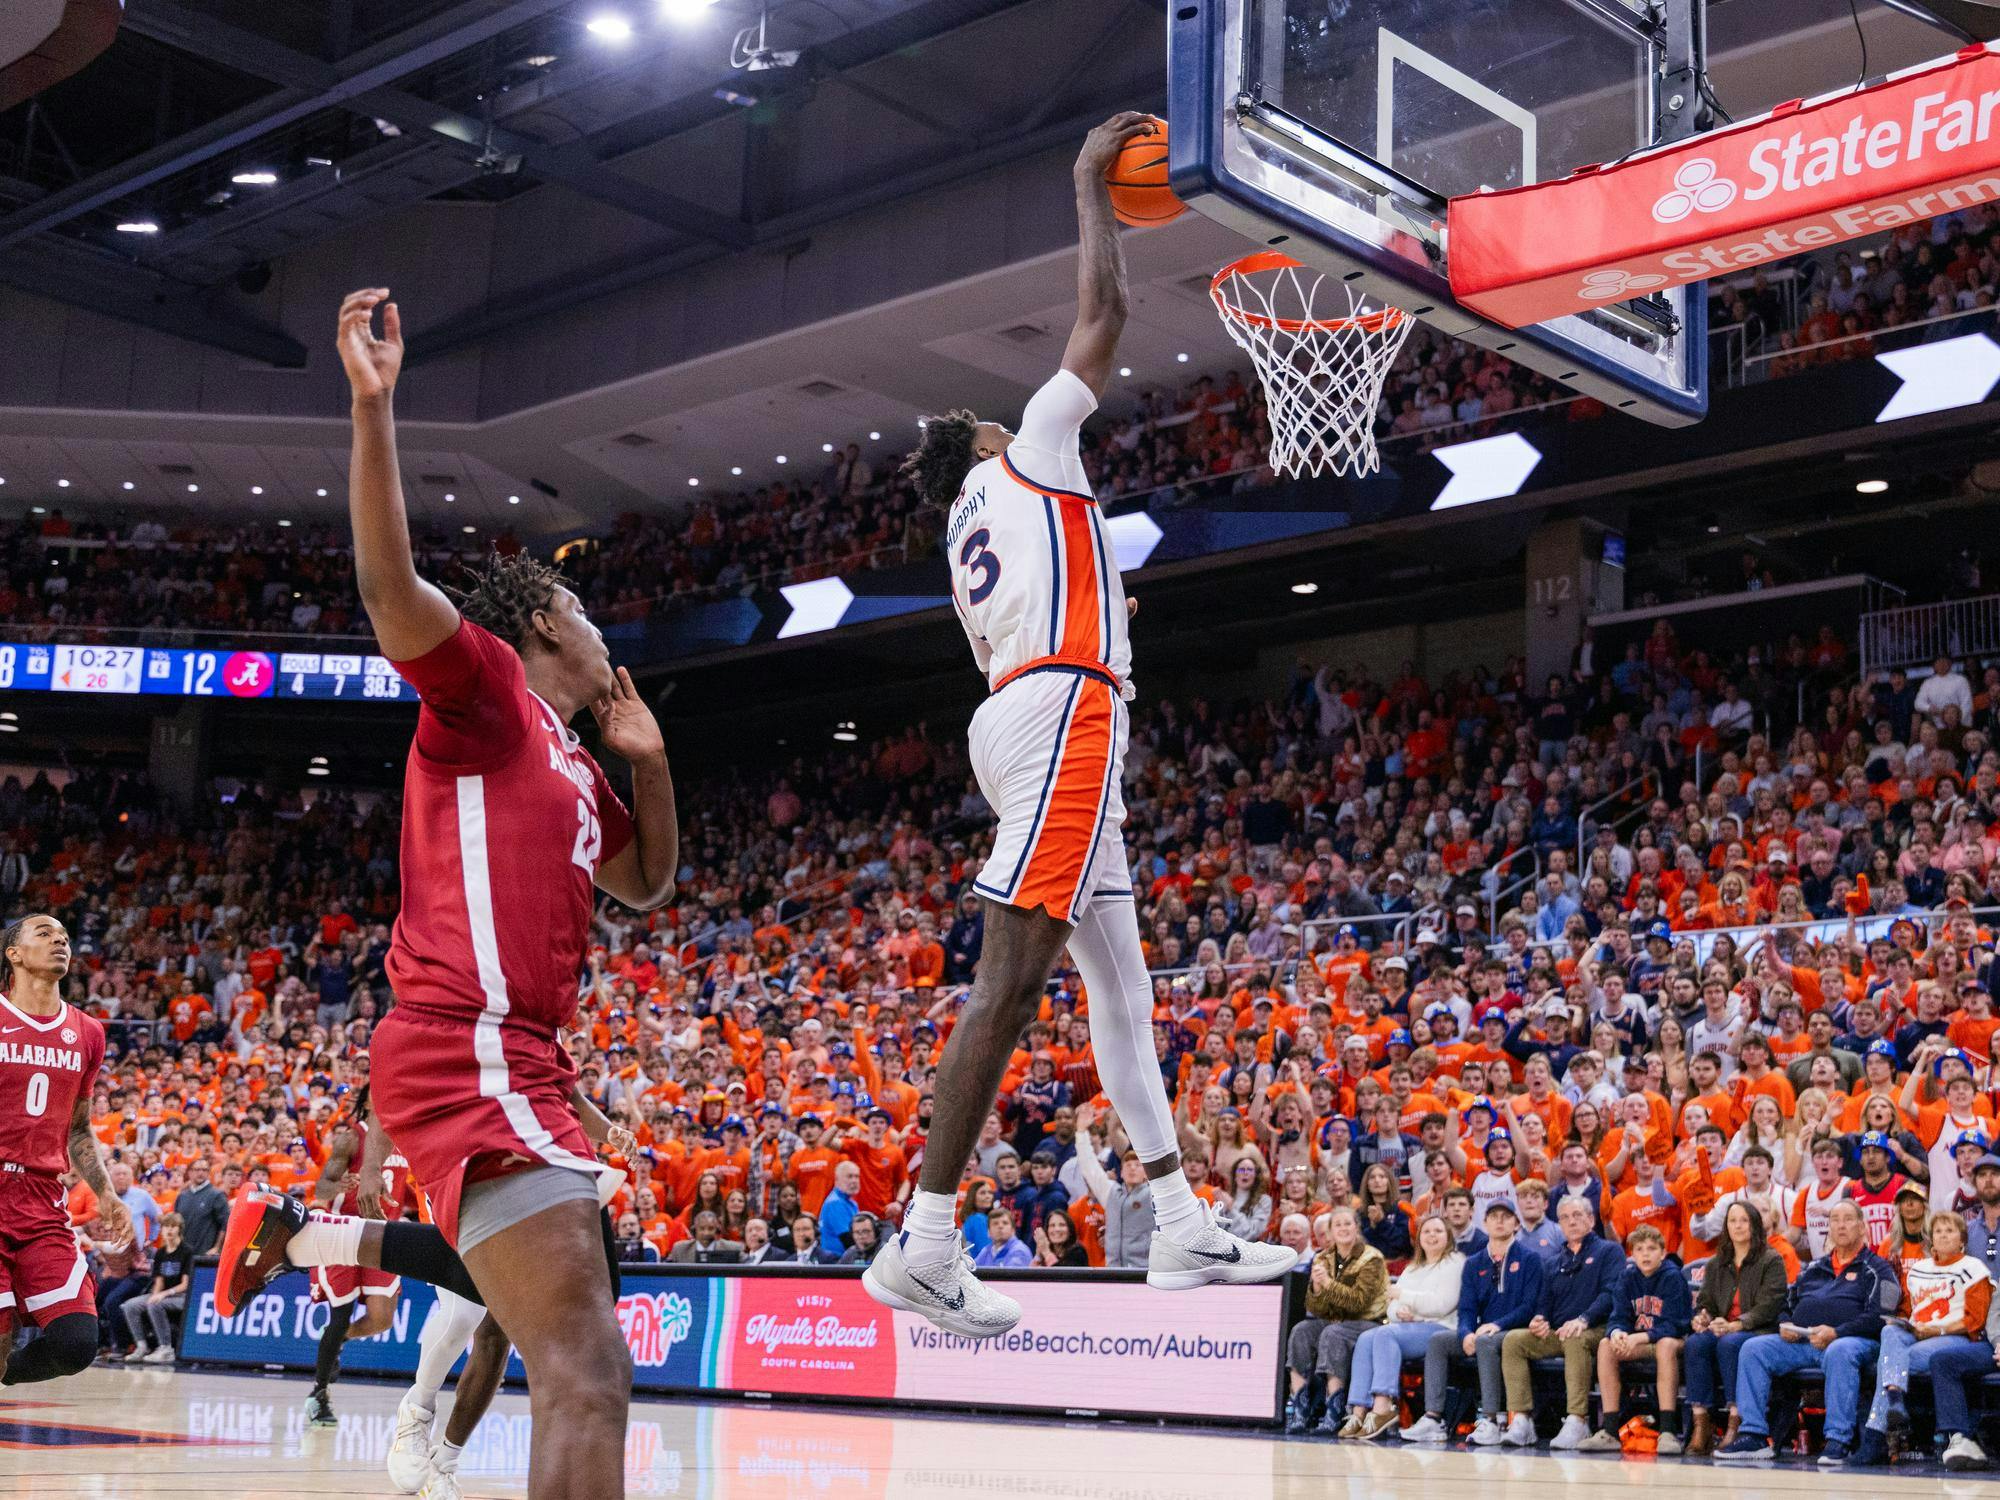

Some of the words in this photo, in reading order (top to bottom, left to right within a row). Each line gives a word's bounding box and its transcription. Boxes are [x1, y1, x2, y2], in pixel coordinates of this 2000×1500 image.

[1744, 115, 1901, 201] State
[1907, 90, 2000, 161] Far
[1662, 226, 1836, 278] State
[960, 528, 1001, 606] 3
[1534, 576, 1571, 602] 112
[67, 650, 134, 668] 10:27
[332, 660, 353, 671] TO
[367, 661, 391, 674] FG
[86, 674, 108, 688] 26
[183, 653, 216, 694] 12
[291, 673, 304, 695] 4
[334, 674, 346, 696] 7
[363, 675, 401, 698] 38.5
[0, 1042, 81, 1072] ALABAMA
[25, 1072, 49, 1117] 0
[796, 1296, 832, 1308] VISIT
[746, 1314, 814, 1354] Myrtle
[815, 1316, 877, 1347] Beach
[761, 1357, 796, 1368] SOUTH
[800, 1360, 855, 1370] CAROLINA
